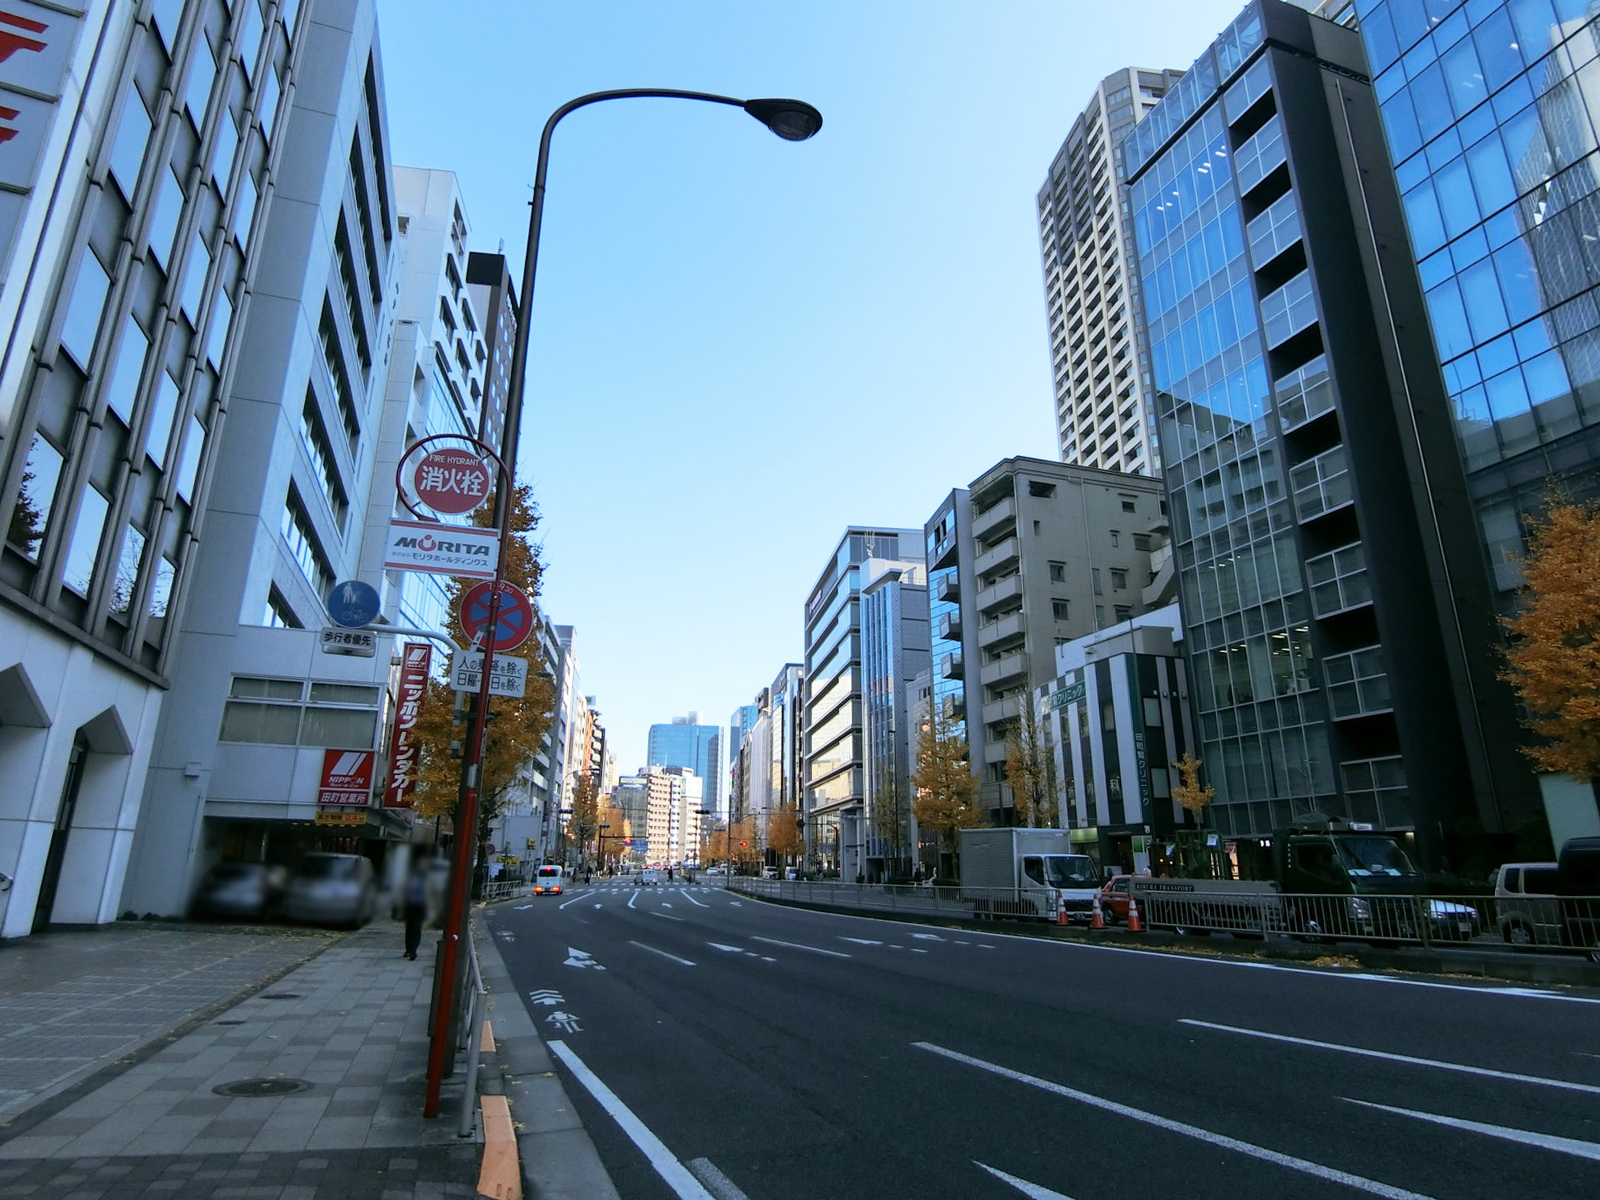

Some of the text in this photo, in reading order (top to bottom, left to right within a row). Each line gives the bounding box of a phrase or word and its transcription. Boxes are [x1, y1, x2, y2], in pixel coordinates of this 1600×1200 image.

[429, 454, 480, 467] FIRE HYDRANT
[420, 465, 485, 496] 消火栓
[394, 534, 490, 556] MORITA
[412, 551, 488, 567] モリタホールディングス
[324, 631, 371, 646] 歩行者優先
[457, 672, 520, 692] 日曜・日を除く
[391, 675, 425, 802] ニッポンレンタカー
[328, 776, 364, 784] NIPPON
[321, 792, 367, 804] 田町営業所
[1159, 884, 1193, 892] TRANSPORT
